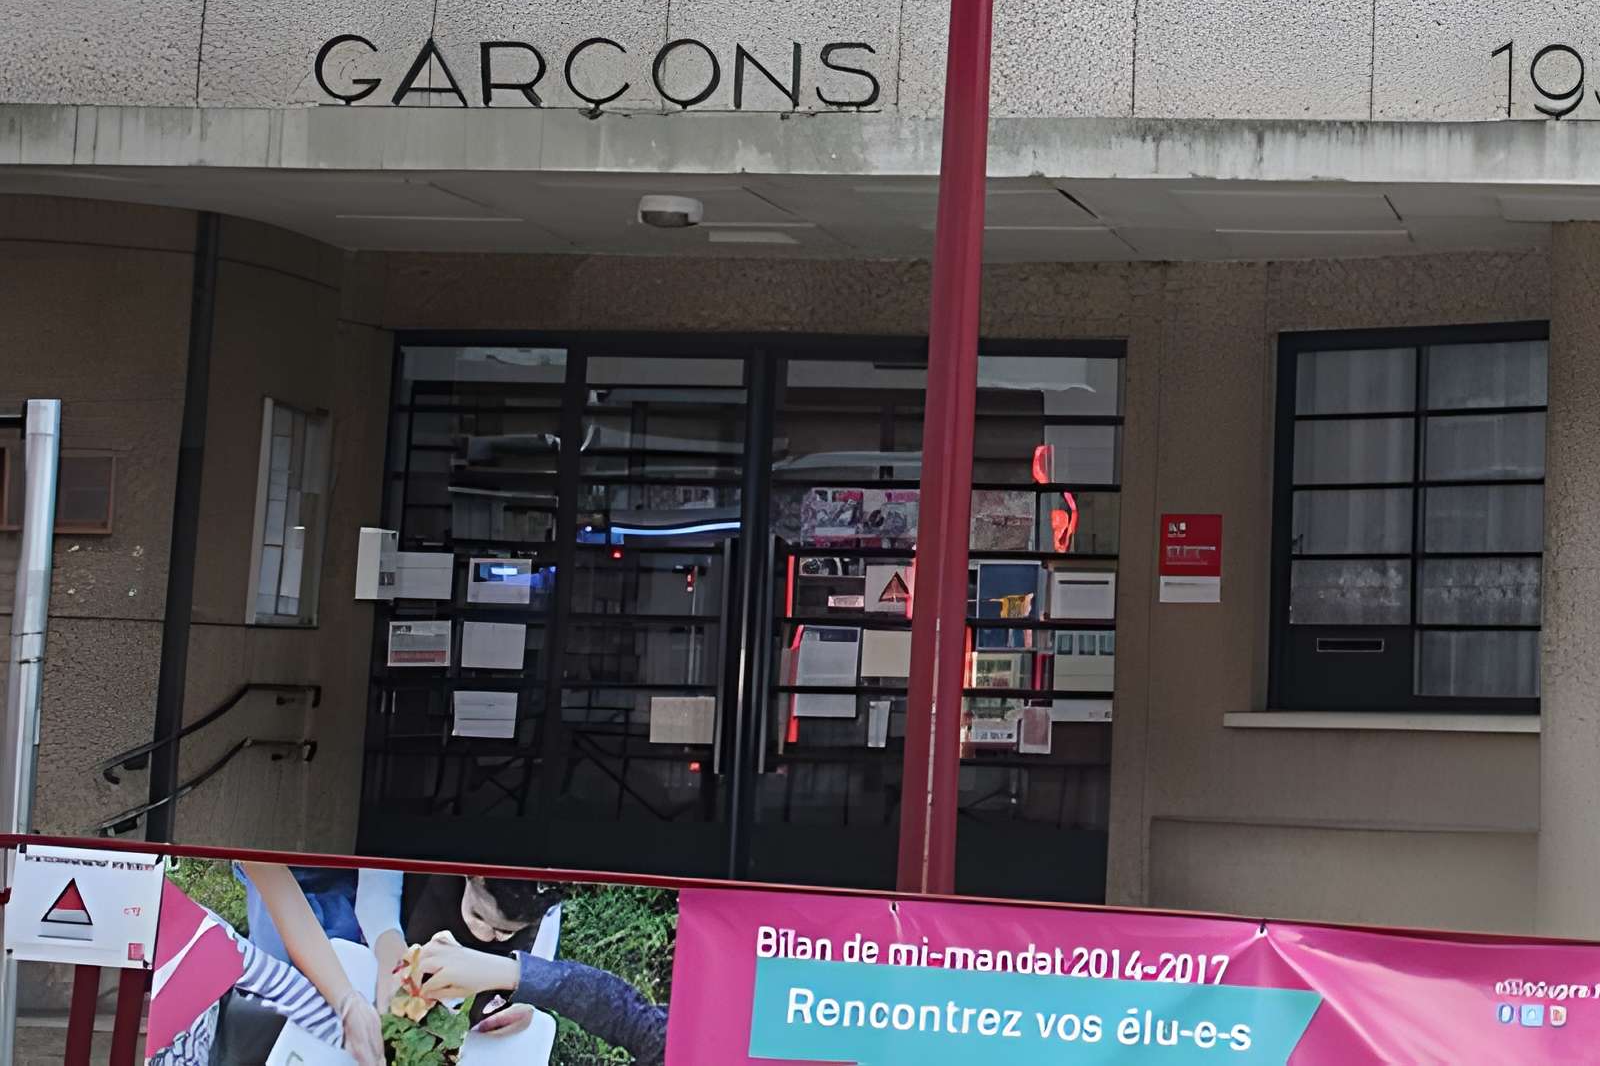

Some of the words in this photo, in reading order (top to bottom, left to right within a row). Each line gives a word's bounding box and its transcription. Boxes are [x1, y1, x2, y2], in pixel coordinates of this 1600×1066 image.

[314, 34, 881, 118] GARÇONS
[755, 926, 832, 961] Bilan
[843, 933, 880, 964] de
[888, 937, 1064, 976] mi-mandat
[1069, 947, 1230, 985] 2014-2017
[786, 987, 1024, 1037] Rencontrez
[1034, 1013, 1103, 1042] vos
